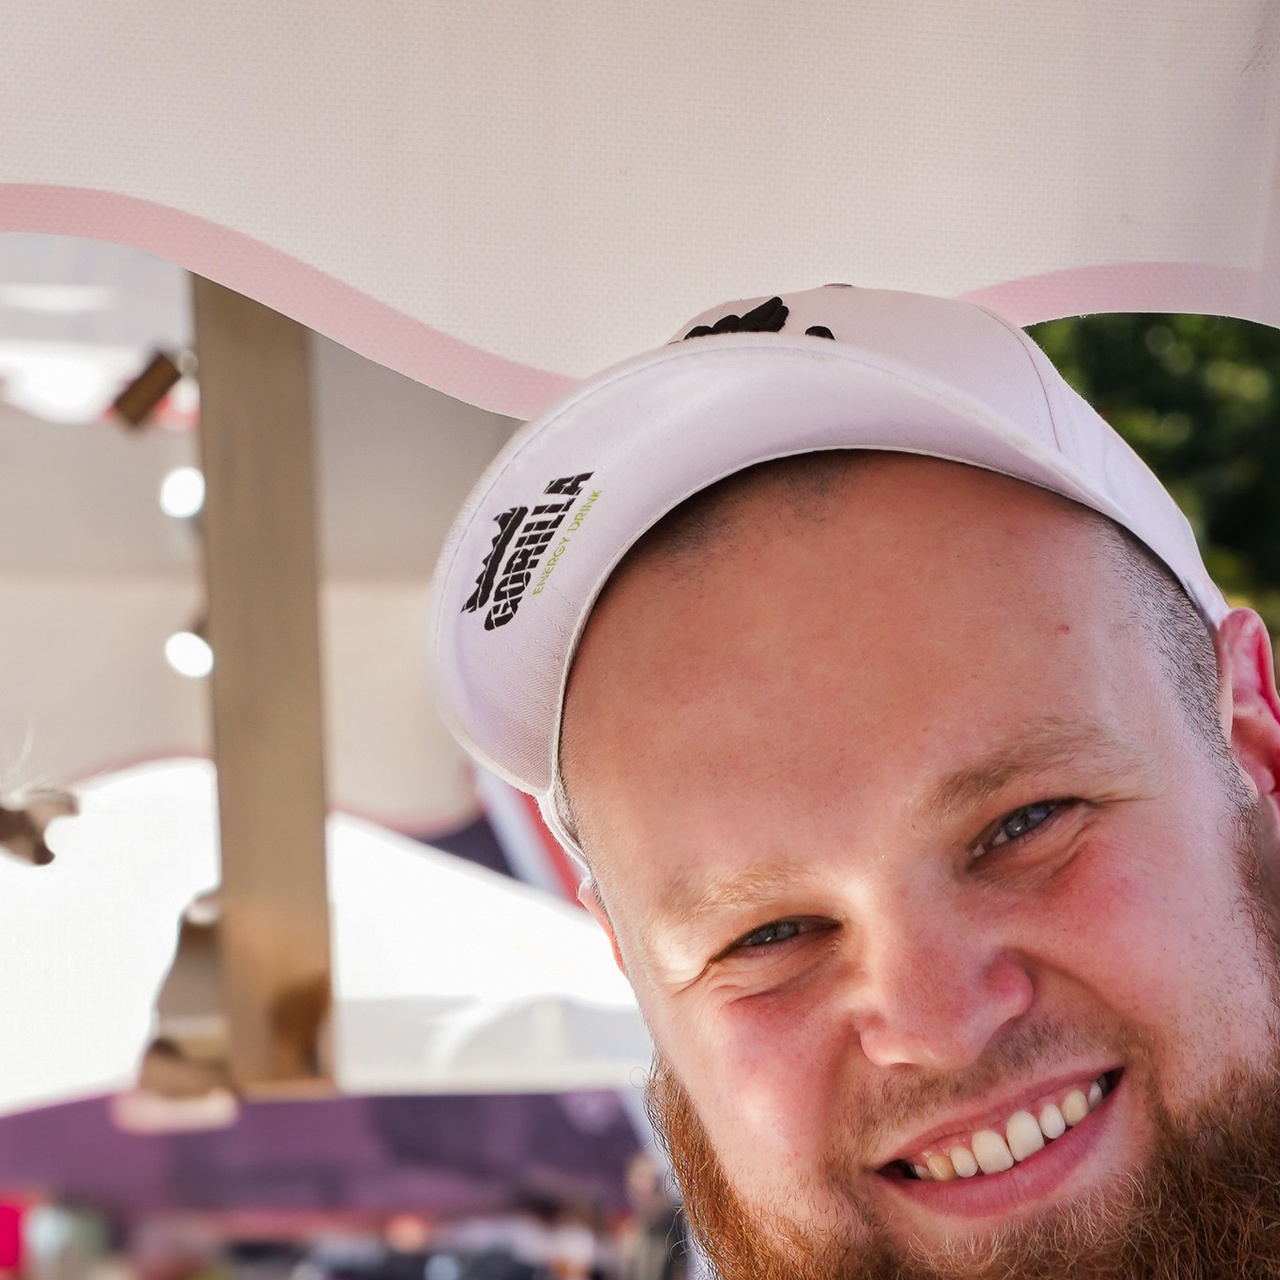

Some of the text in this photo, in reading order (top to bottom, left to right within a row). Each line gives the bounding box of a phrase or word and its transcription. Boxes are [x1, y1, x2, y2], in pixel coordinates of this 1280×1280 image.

[484, 471, 595, 631] GORILLA
[532, 489, 604, 596] ENERGY DRINK
